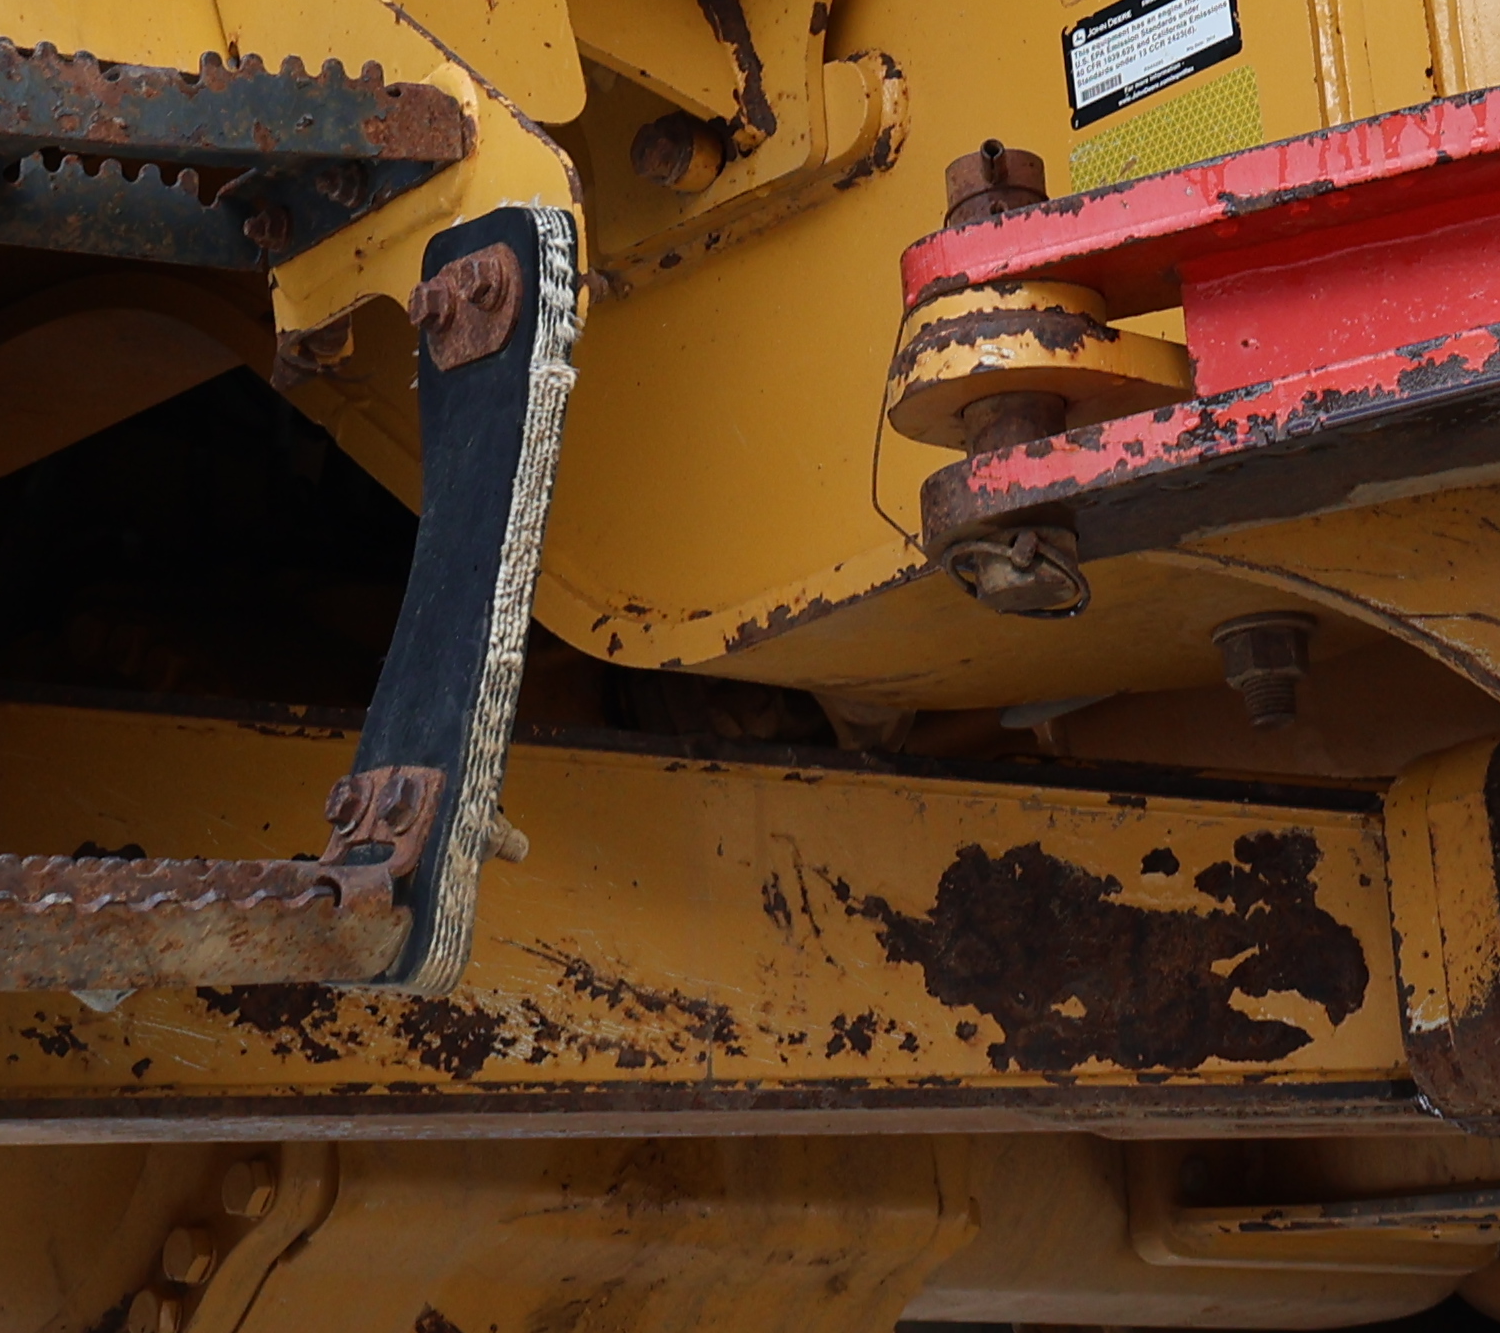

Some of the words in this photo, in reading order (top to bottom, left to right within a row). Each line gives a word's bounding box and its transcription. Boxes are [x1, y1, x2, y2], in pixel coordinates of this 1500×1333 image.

[1074, 45, 1090, 60] This
[1091, 25, 1130, 52] equipment
[1131, 18, 1145, 32] has
[1146, 14, 1156, 25] an
[1157, 1, 1182, 21] engine
[1074, 55, 1090, 69] U.S.
[1090, 47, 1105, 62] EPA
[1106, 31, 1139, 54] Emission
[1140, 13, 1177, 38] Standards
[1178, 2, 1200, 20] under
[1085, 59, 1102, 74] CFR
[1135, 36, 1150, 50] and
[1151, 18, 1187, 42] California
[1086, 19, 1107, 39] JOHN
[1107, 7, 1132, 29] DEERE
[1076, 63, 1113, 88] Standards
[1114, 52, 1137, 70] under
[1138, 47, 1147, 58] 13
[1148, 38, 1166, 53] CCR
